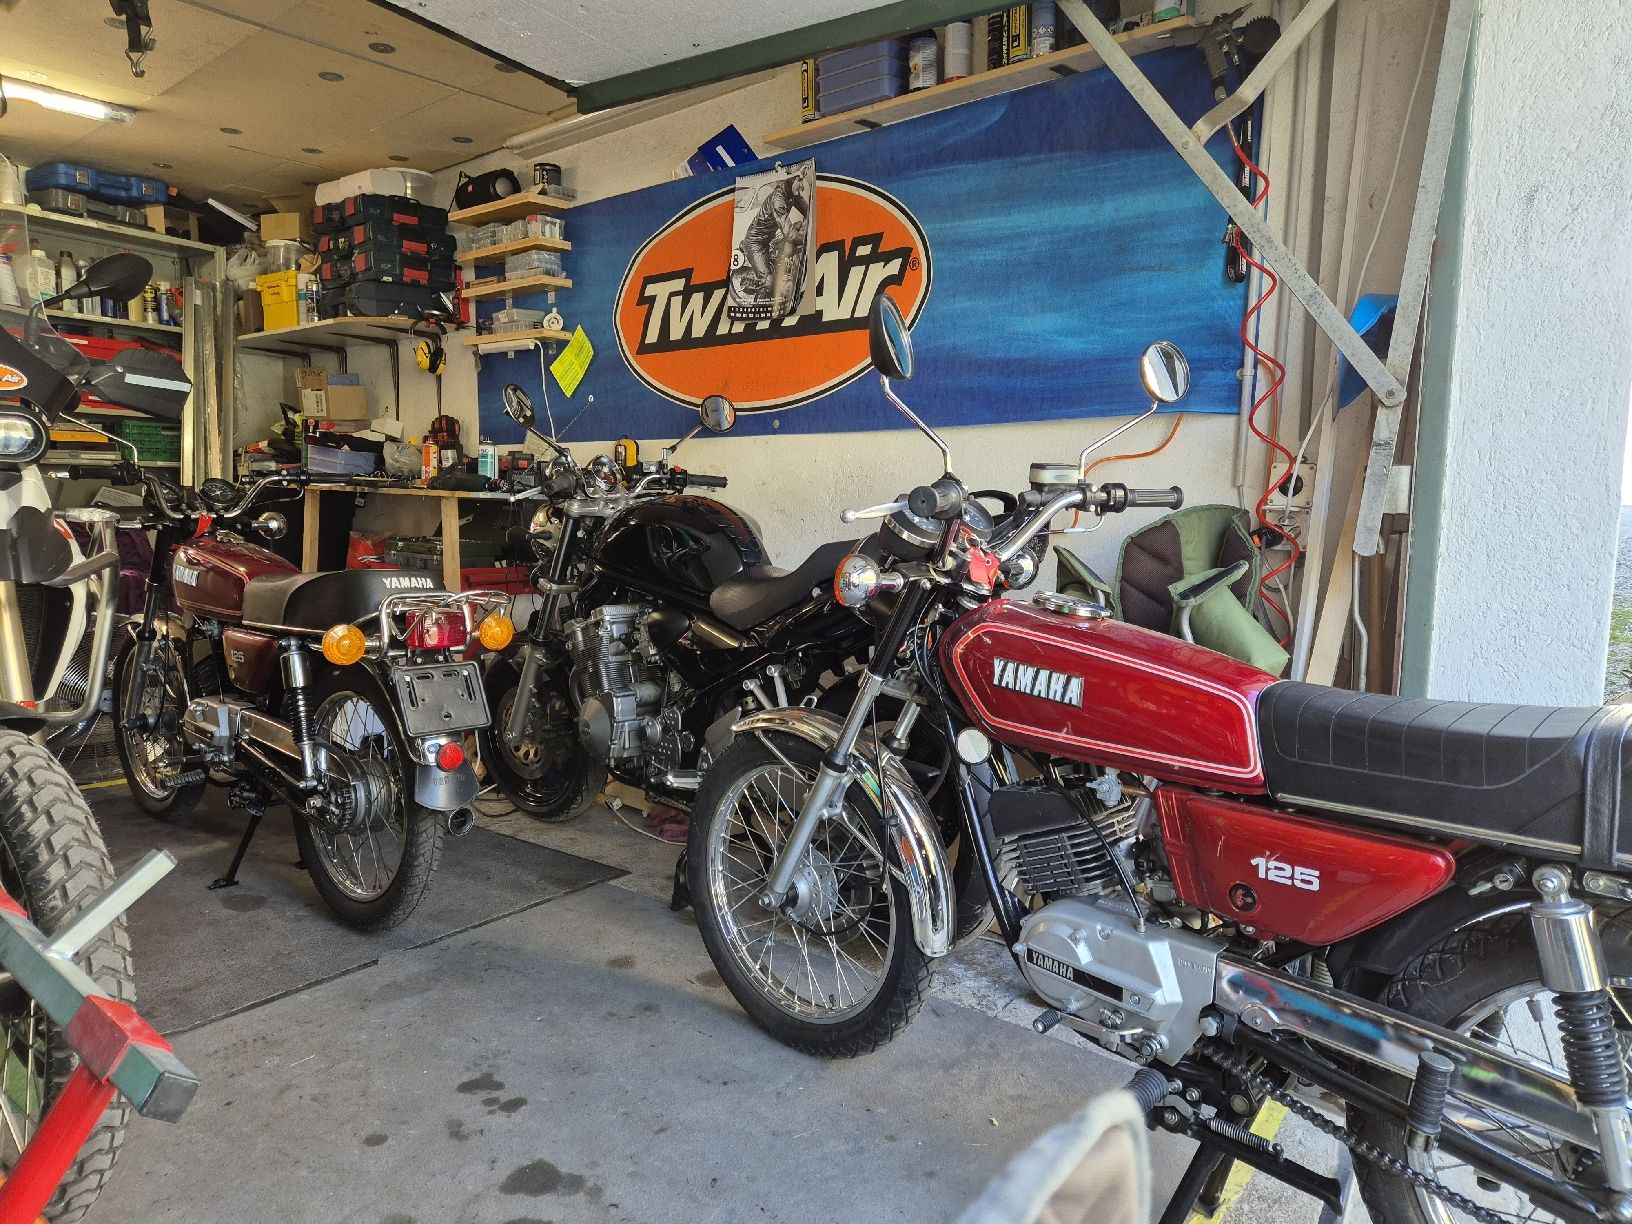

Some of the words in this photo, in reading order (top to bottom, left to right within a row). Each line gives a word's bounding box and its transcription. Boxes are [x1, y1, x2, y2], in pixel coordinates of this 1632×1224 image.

[733, 254, 740, 267] 8
[382, 577, 434, 589] YAMAHA
[231, 650, 245, 663] 125
[993, 657, 1083, 709] YAMAHA
[1250, 857, 1320, 892] 125
[1032, 951, 1074, 981] YAMAHA
